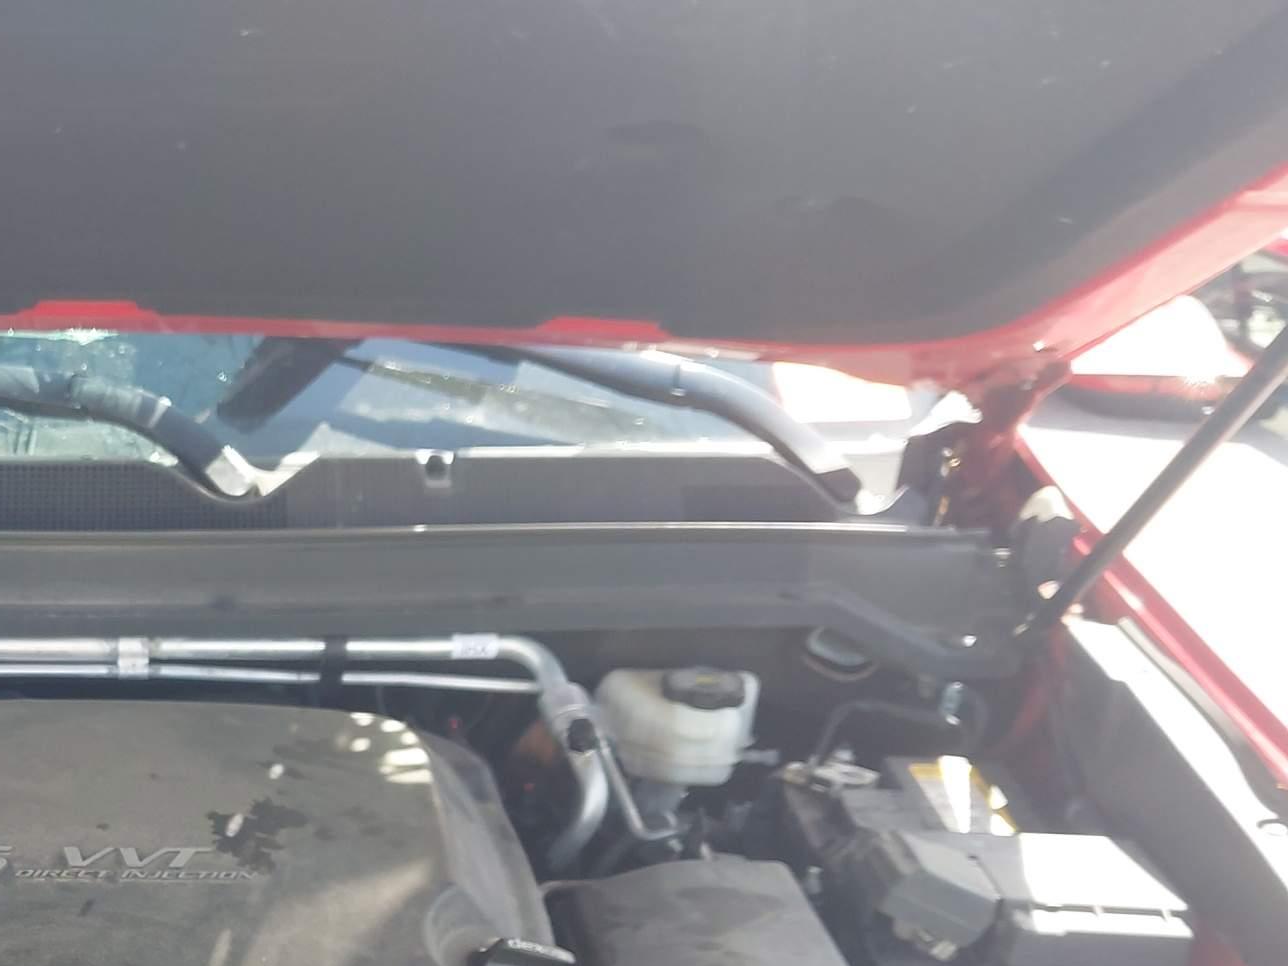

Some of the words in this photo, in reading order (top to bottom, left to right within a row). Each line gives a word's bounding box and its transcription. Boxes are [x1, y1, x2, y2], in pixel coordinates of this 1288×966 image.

[62, 845, 215, 869] VVT
[15, 868, 111, 879] DIRECT
[120, 867, 260, 881] INJECTION
